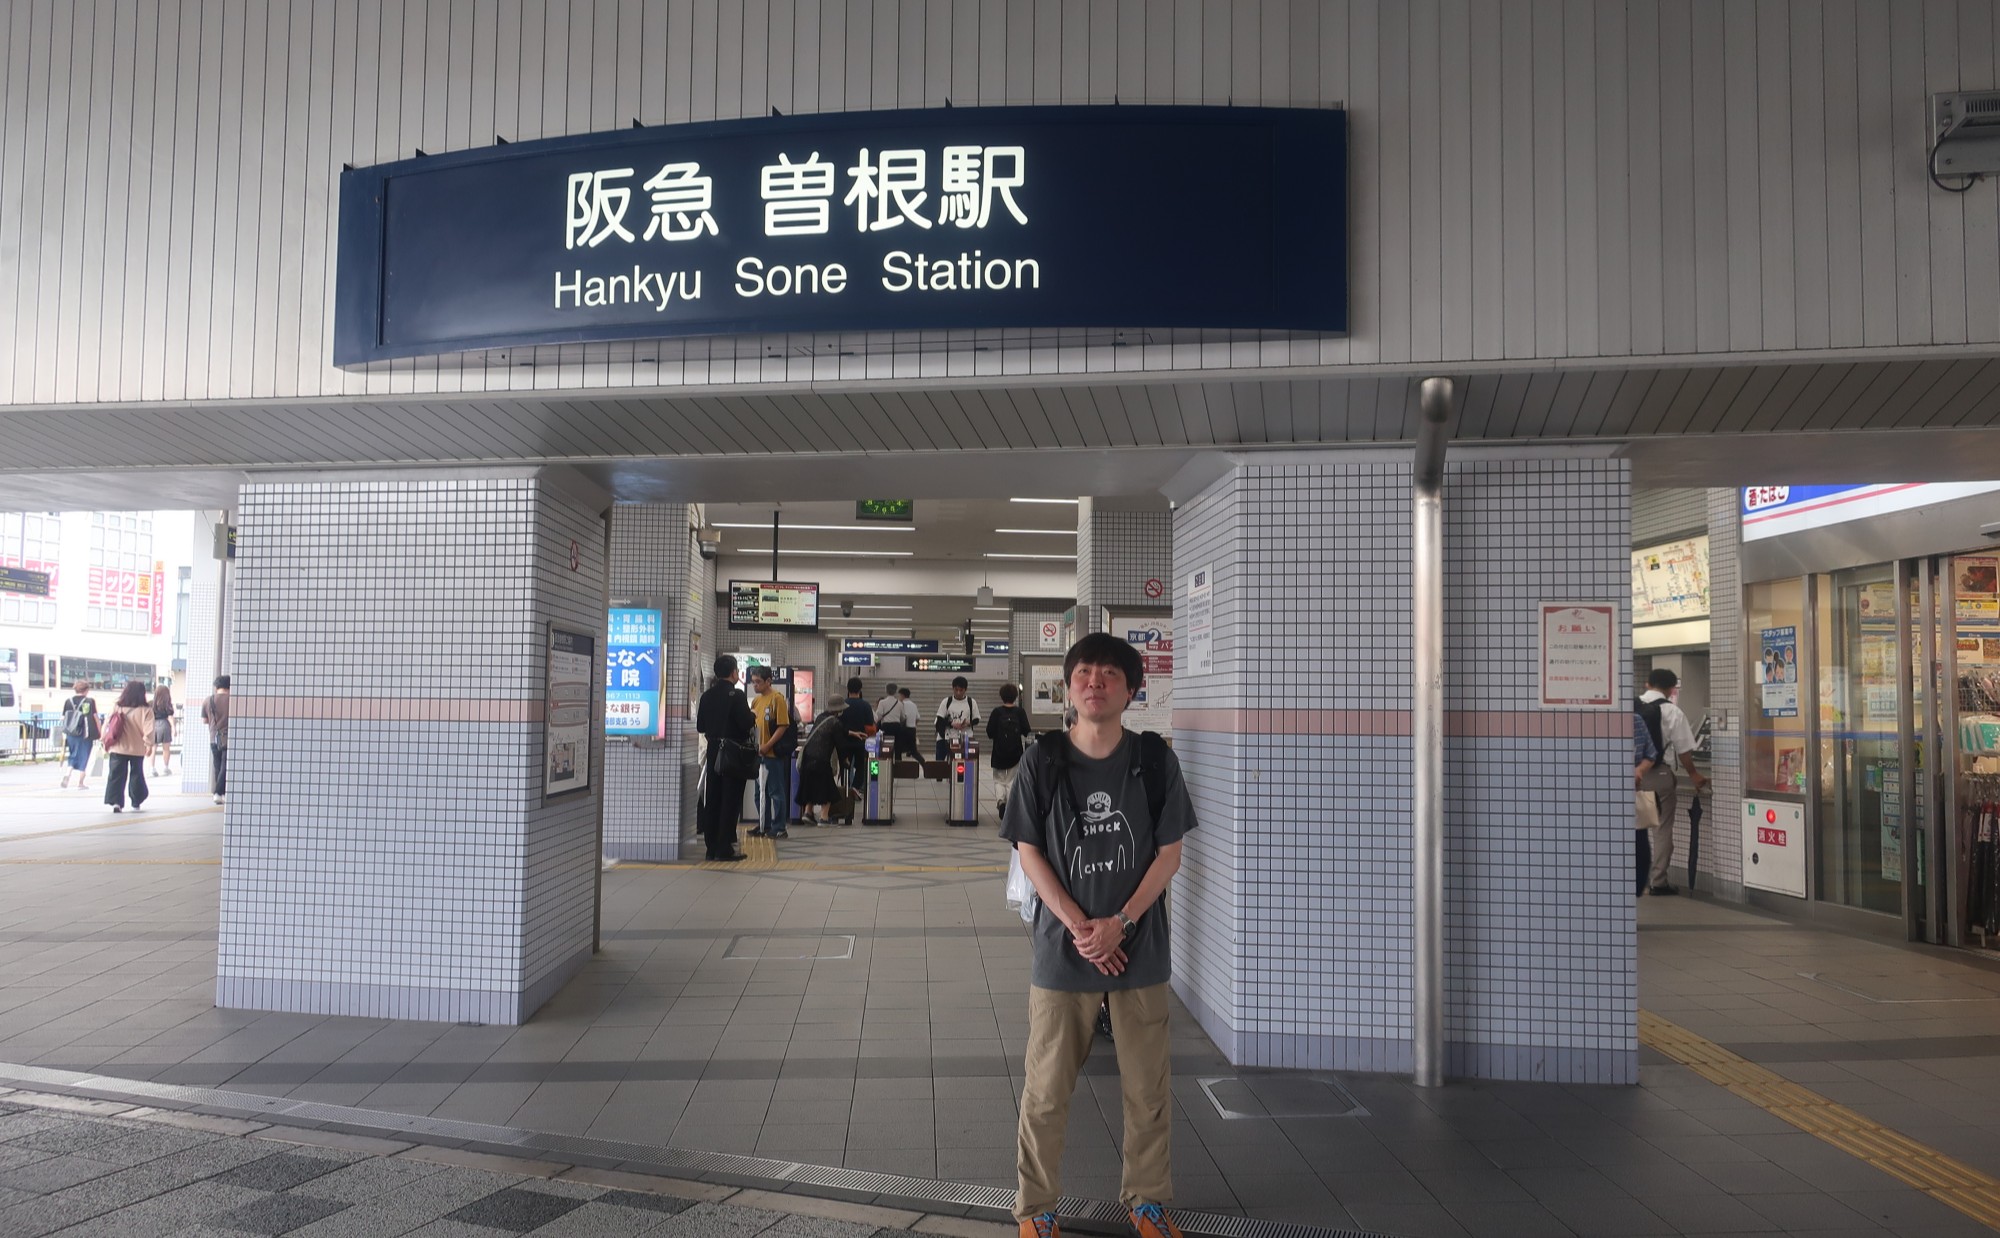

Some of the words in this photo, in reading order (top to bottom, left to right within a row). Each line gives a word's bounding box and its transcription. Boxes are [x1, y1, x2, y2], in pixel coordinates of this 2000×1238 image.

[566, 161, 719, 250] 阪急
[761, 145, 1028, 237] 曽根駅
[554, 265, 702, 311] Hankyu
[735, 256, 848, 297] Sone
[881, 250, 1039, 291] Station
[1148, 630, 1159, 645] 2
[1083, 821, 1121, 836] SHOCK
[1758, 829, 1786, 845] 消火栓
[1084, 860, 1113, 874] CITY
